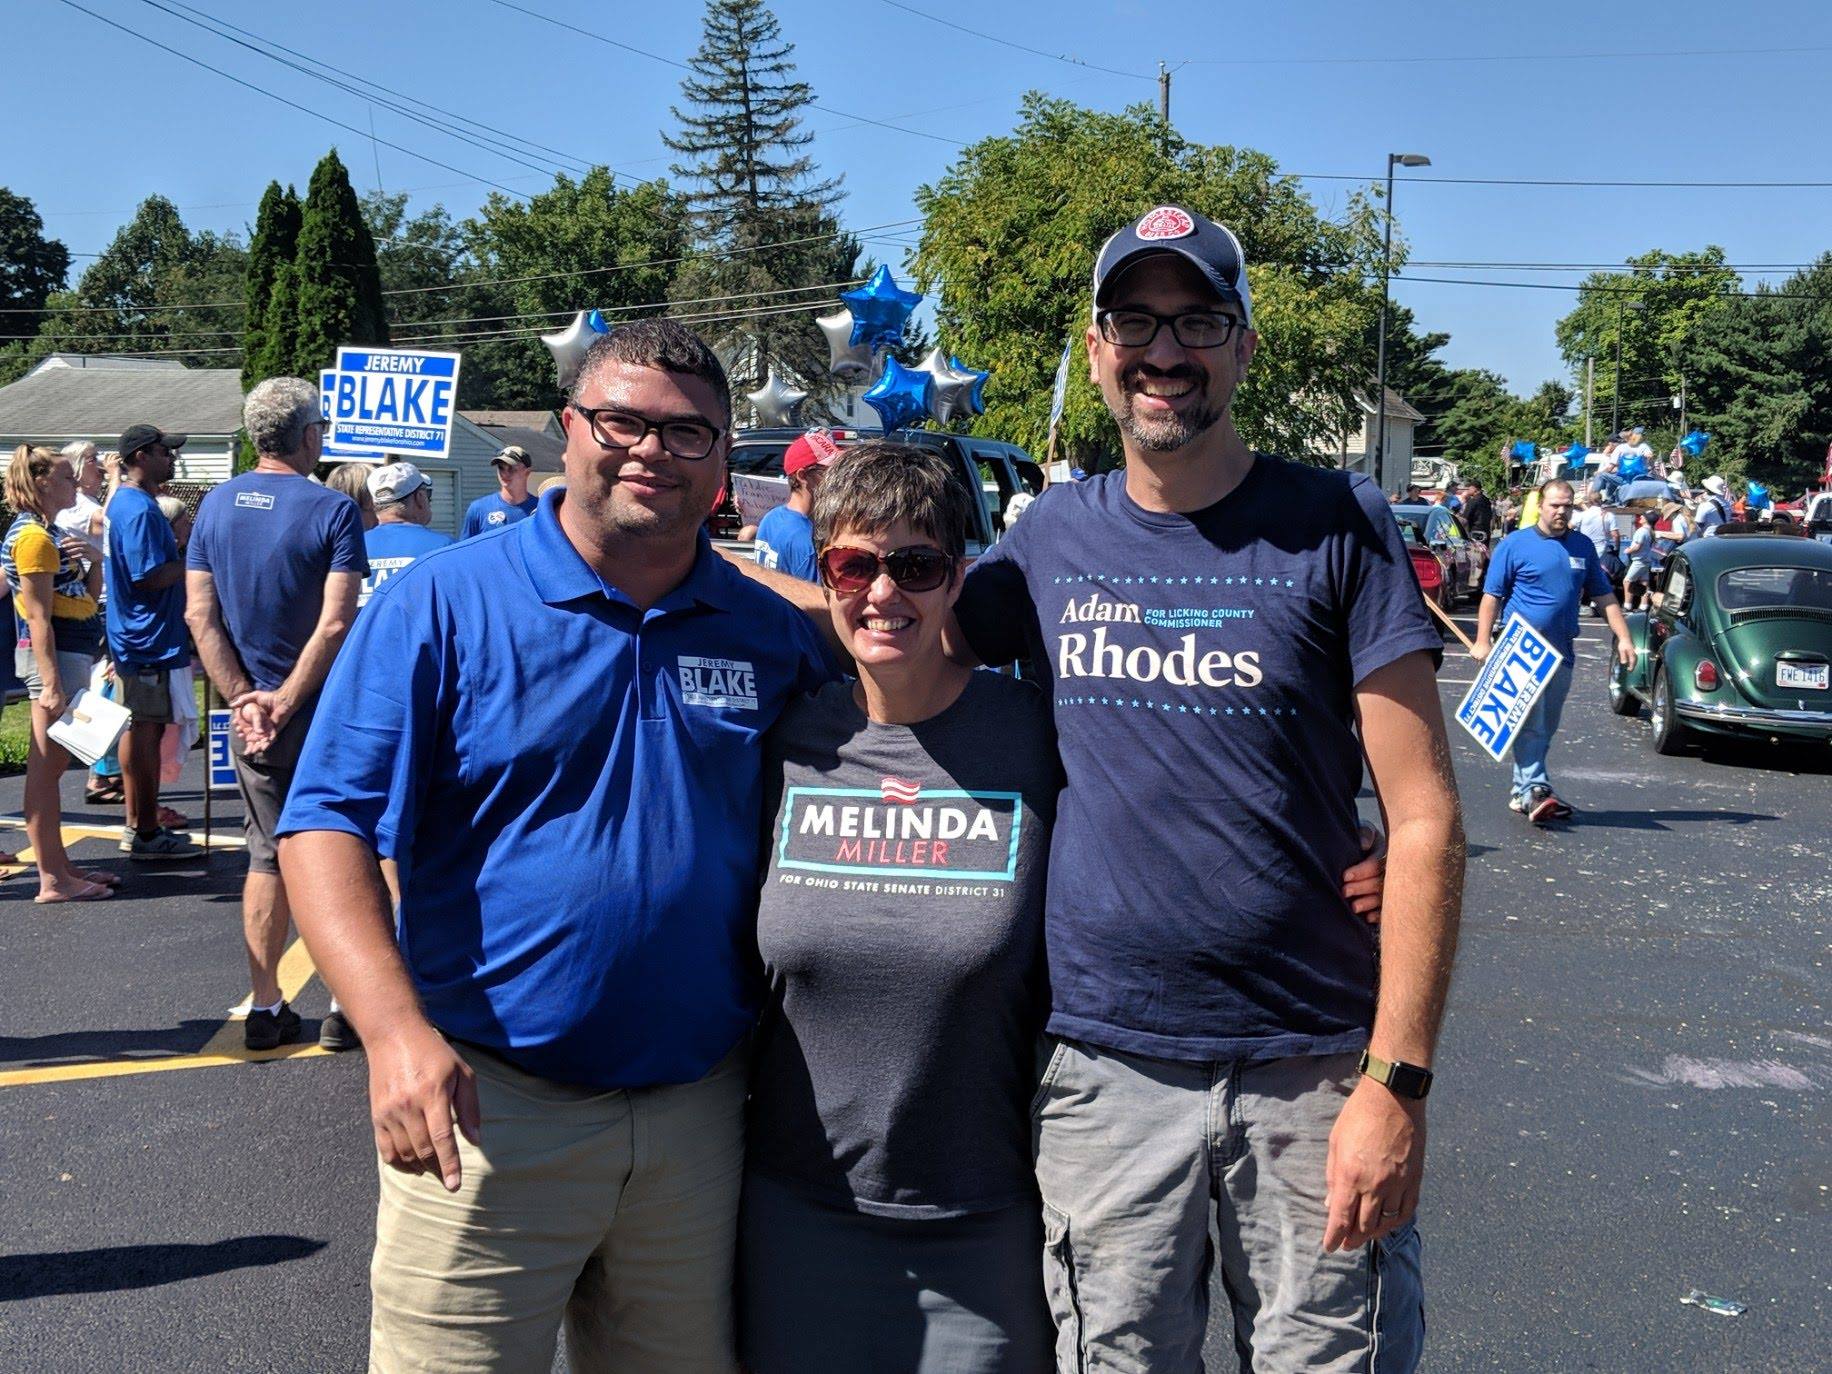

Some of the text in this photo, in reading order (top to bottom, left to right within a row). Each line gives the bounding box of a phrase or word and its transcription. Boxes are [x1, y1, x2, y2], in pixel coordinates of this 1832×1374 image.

[364, 355, 425, 373] JEREMY
[336, 375, 452, 425] BLAKE
[337, 424, 444, 441] STATE REPRESENTATIVE DISTRICT 71
[1059, 593, 1255, 624] Adam FOR LICKING COUNTY
[1144, 618, 1223, 629] COMMISSIONER
[698, 659, 735, 669] JEREMY
[1058, 626, 1263, 687] Rhodes
[679, 667, 757, 697] BLAKE
[1470, 630, 1546, 745] BLAKE
[1508, 674, 1540, 732] JEREMY
[800, 804, 999, 841] MELINDA
[835, 838, 950, 865] MILLER
[779, 874, 1004, 898] FOR OHIO STATE SENATE DISTRICT 31
